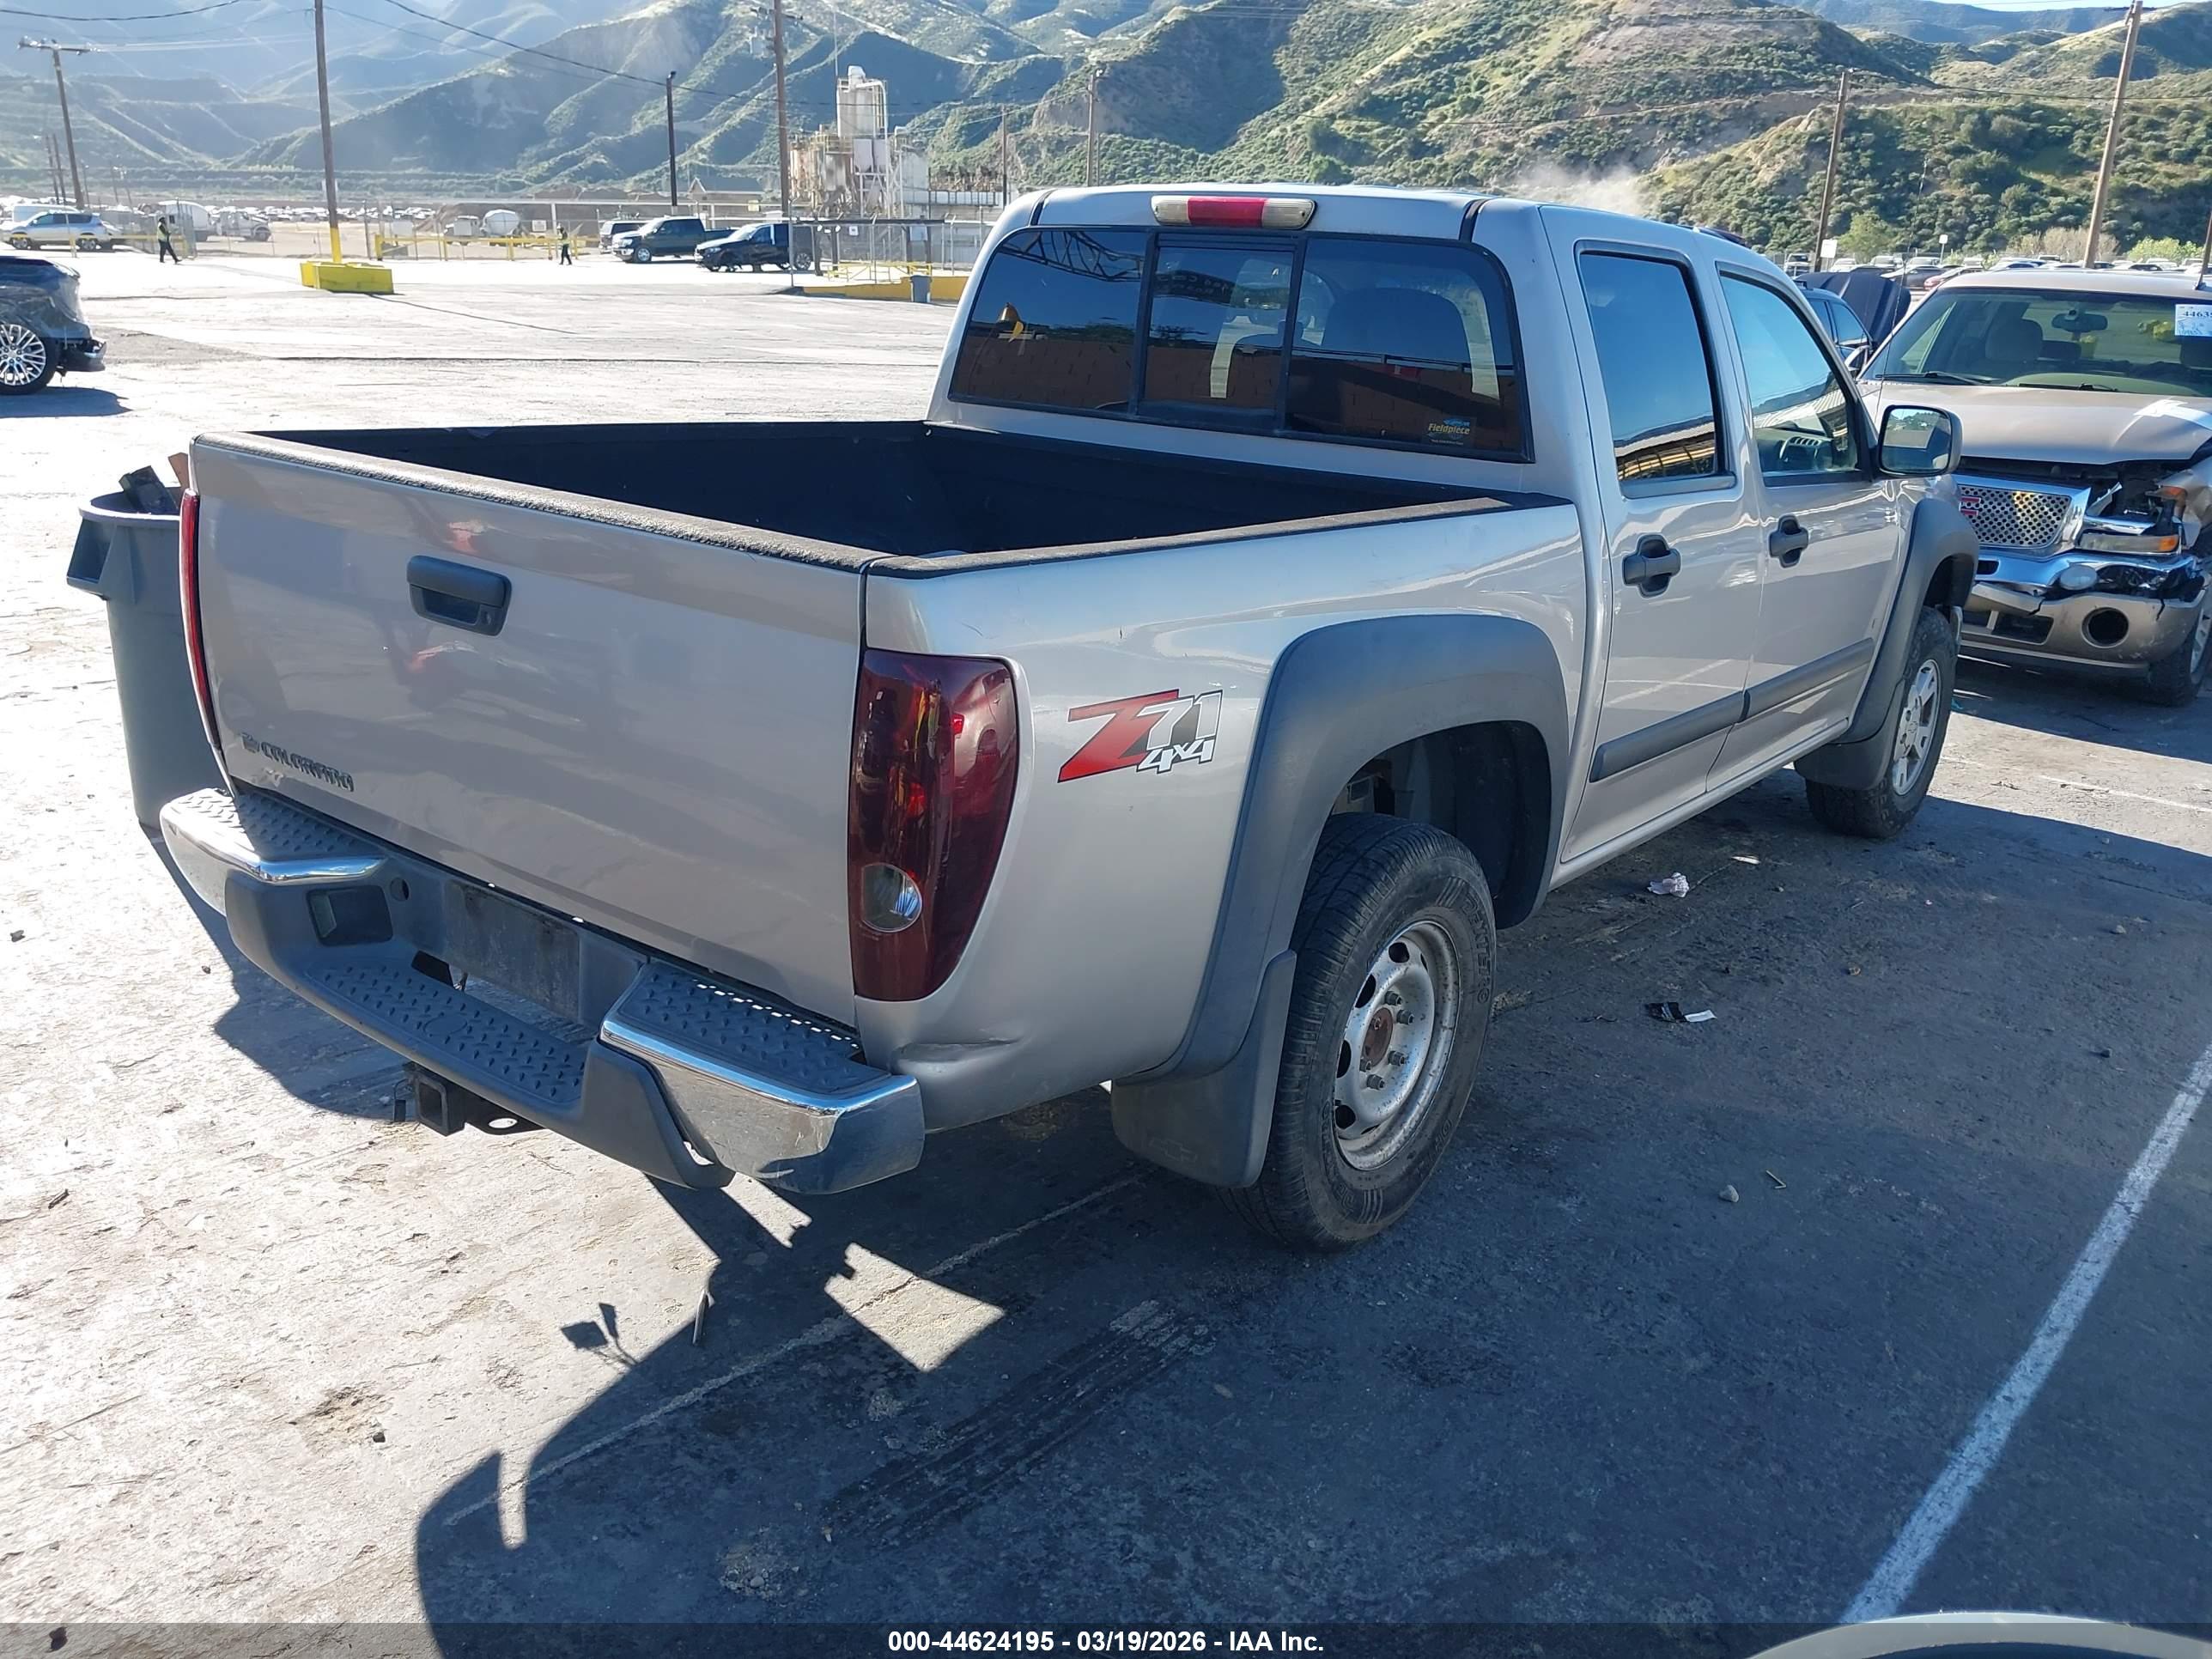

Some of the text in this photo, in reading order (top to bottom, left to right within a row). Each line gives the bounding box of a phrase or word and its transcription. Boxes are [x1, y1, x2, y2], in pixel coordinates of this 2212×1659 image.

[1428, 422, 1470, 434] Fieldpiece
[1057, 689, 1223, 783] Z71
[260, 741, 355, 792] COLORADO
